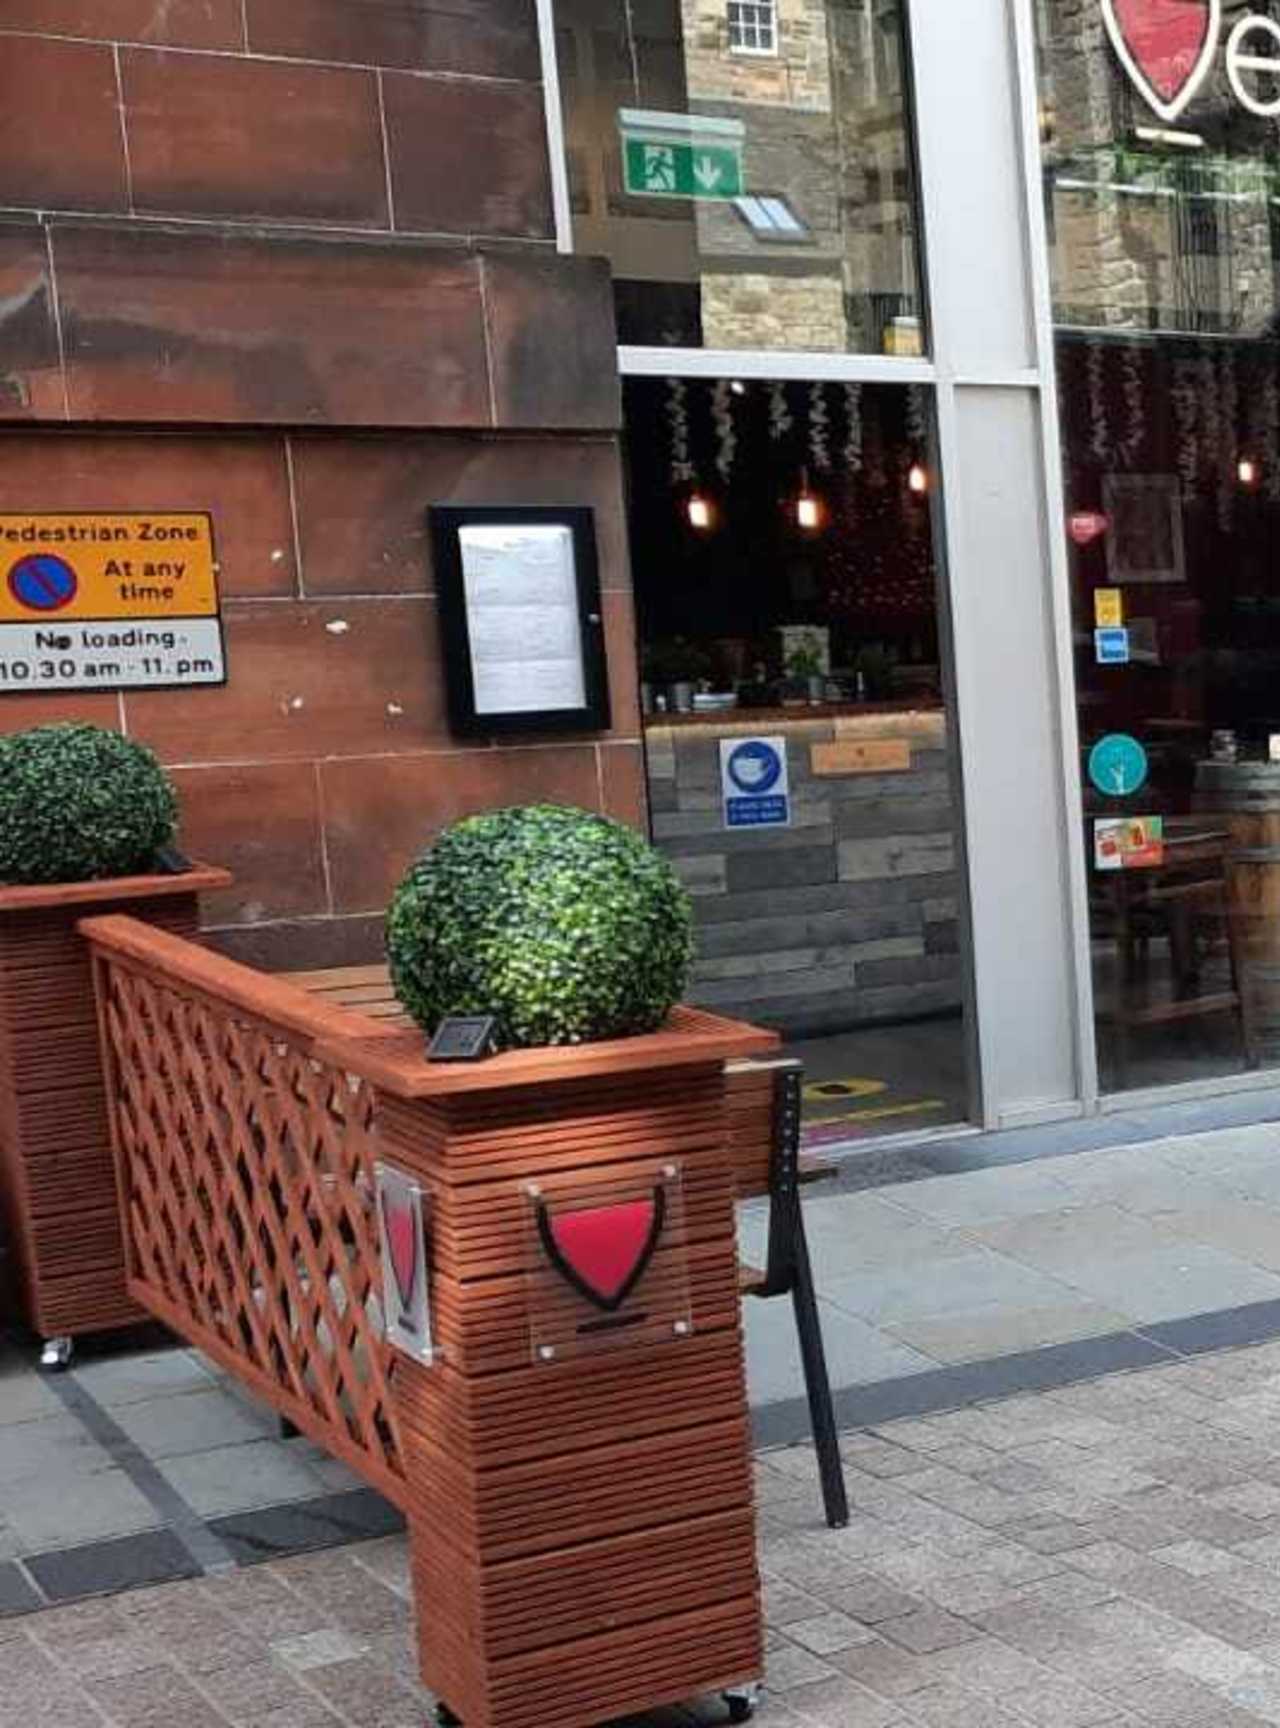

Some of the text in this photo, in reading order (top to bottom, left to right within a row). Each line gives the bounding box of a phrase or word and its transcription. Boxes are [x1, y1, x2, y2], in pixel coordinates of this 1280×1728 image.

[138, 523, 198, 541] Zone
[104, 559, 187, 580] At any
[119, 583, 174, 600] time
[35, 629, 176, 650] No loading
[83, 662, 121, 678] am
